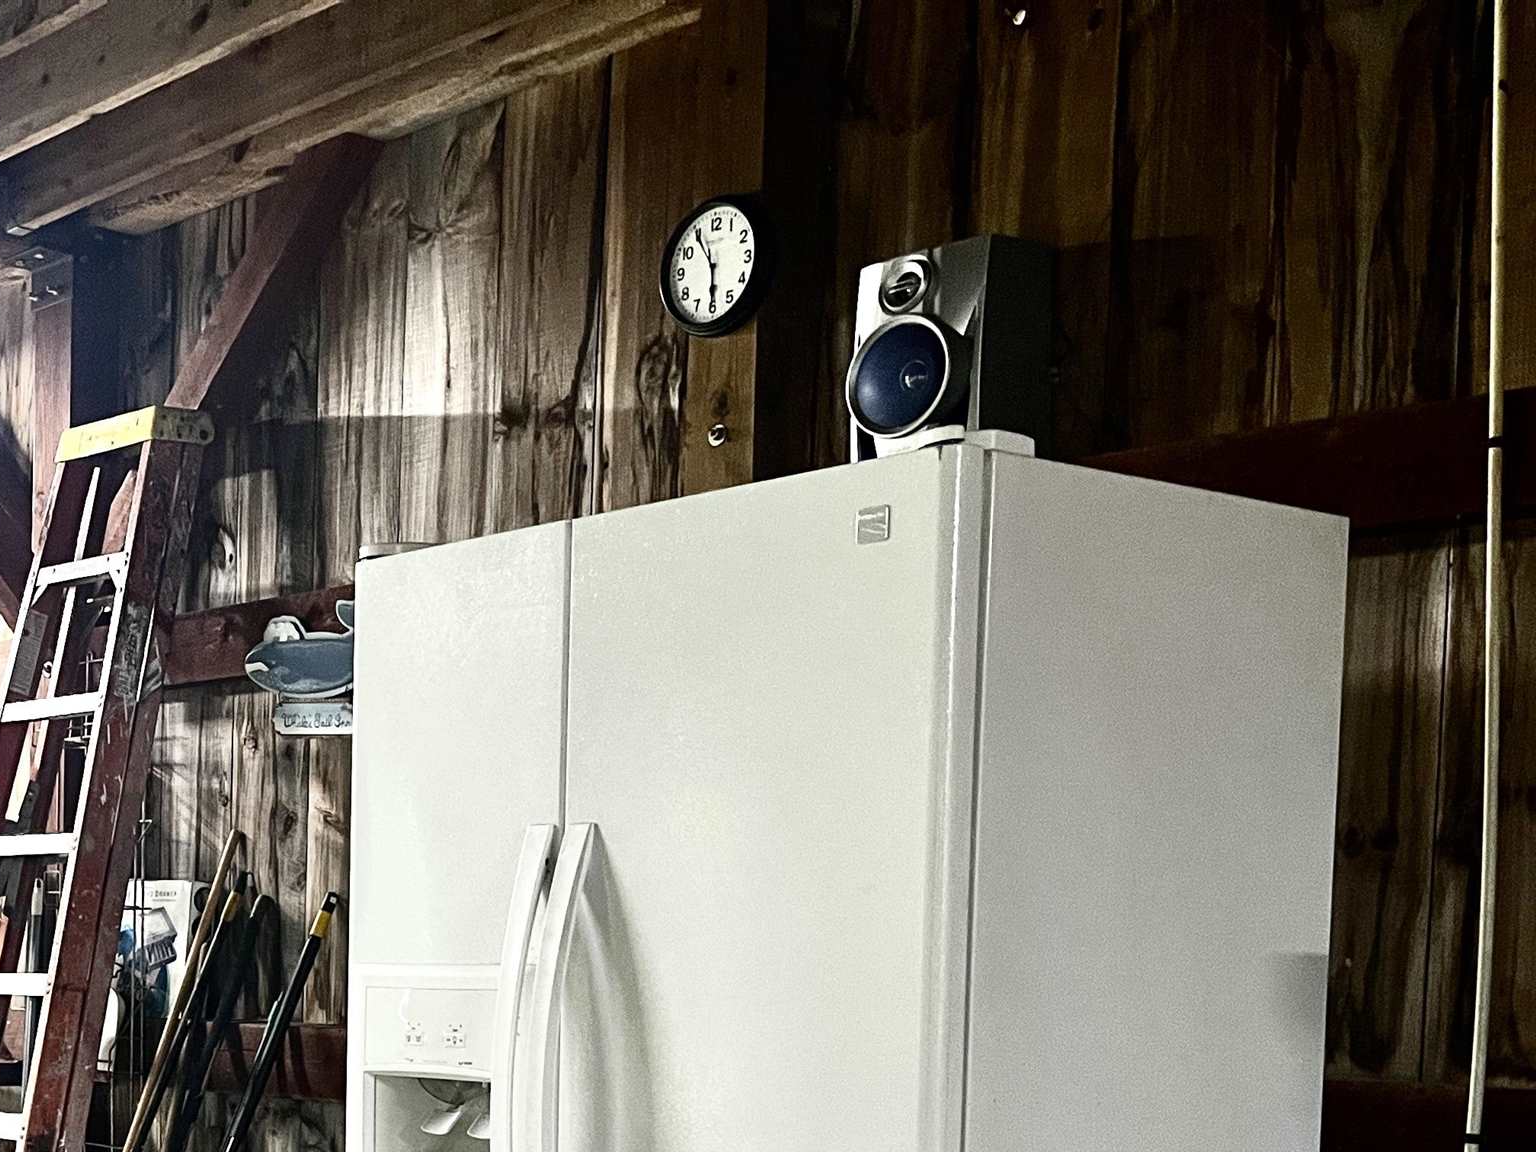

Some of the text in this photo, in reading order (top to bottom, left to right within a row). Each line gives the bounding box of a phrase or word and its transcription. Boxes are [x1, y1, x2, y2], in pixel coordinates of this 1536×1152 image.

[711, 217, 722, 232] 12
[729, 217, 734, 232] 1
[739, 229, 748, 243] 2
[682, 246, 694, 260] 10
[743, 250, 752, 264] 3
[676, 267, 685, 281] 9
[738, 271, 746, 285] 4
[681, 287, 690, 301] 8
[725, 289, 734, 304] 5
[693, 298, 701, 312] 7
[708, 300, 717, 314] 6
